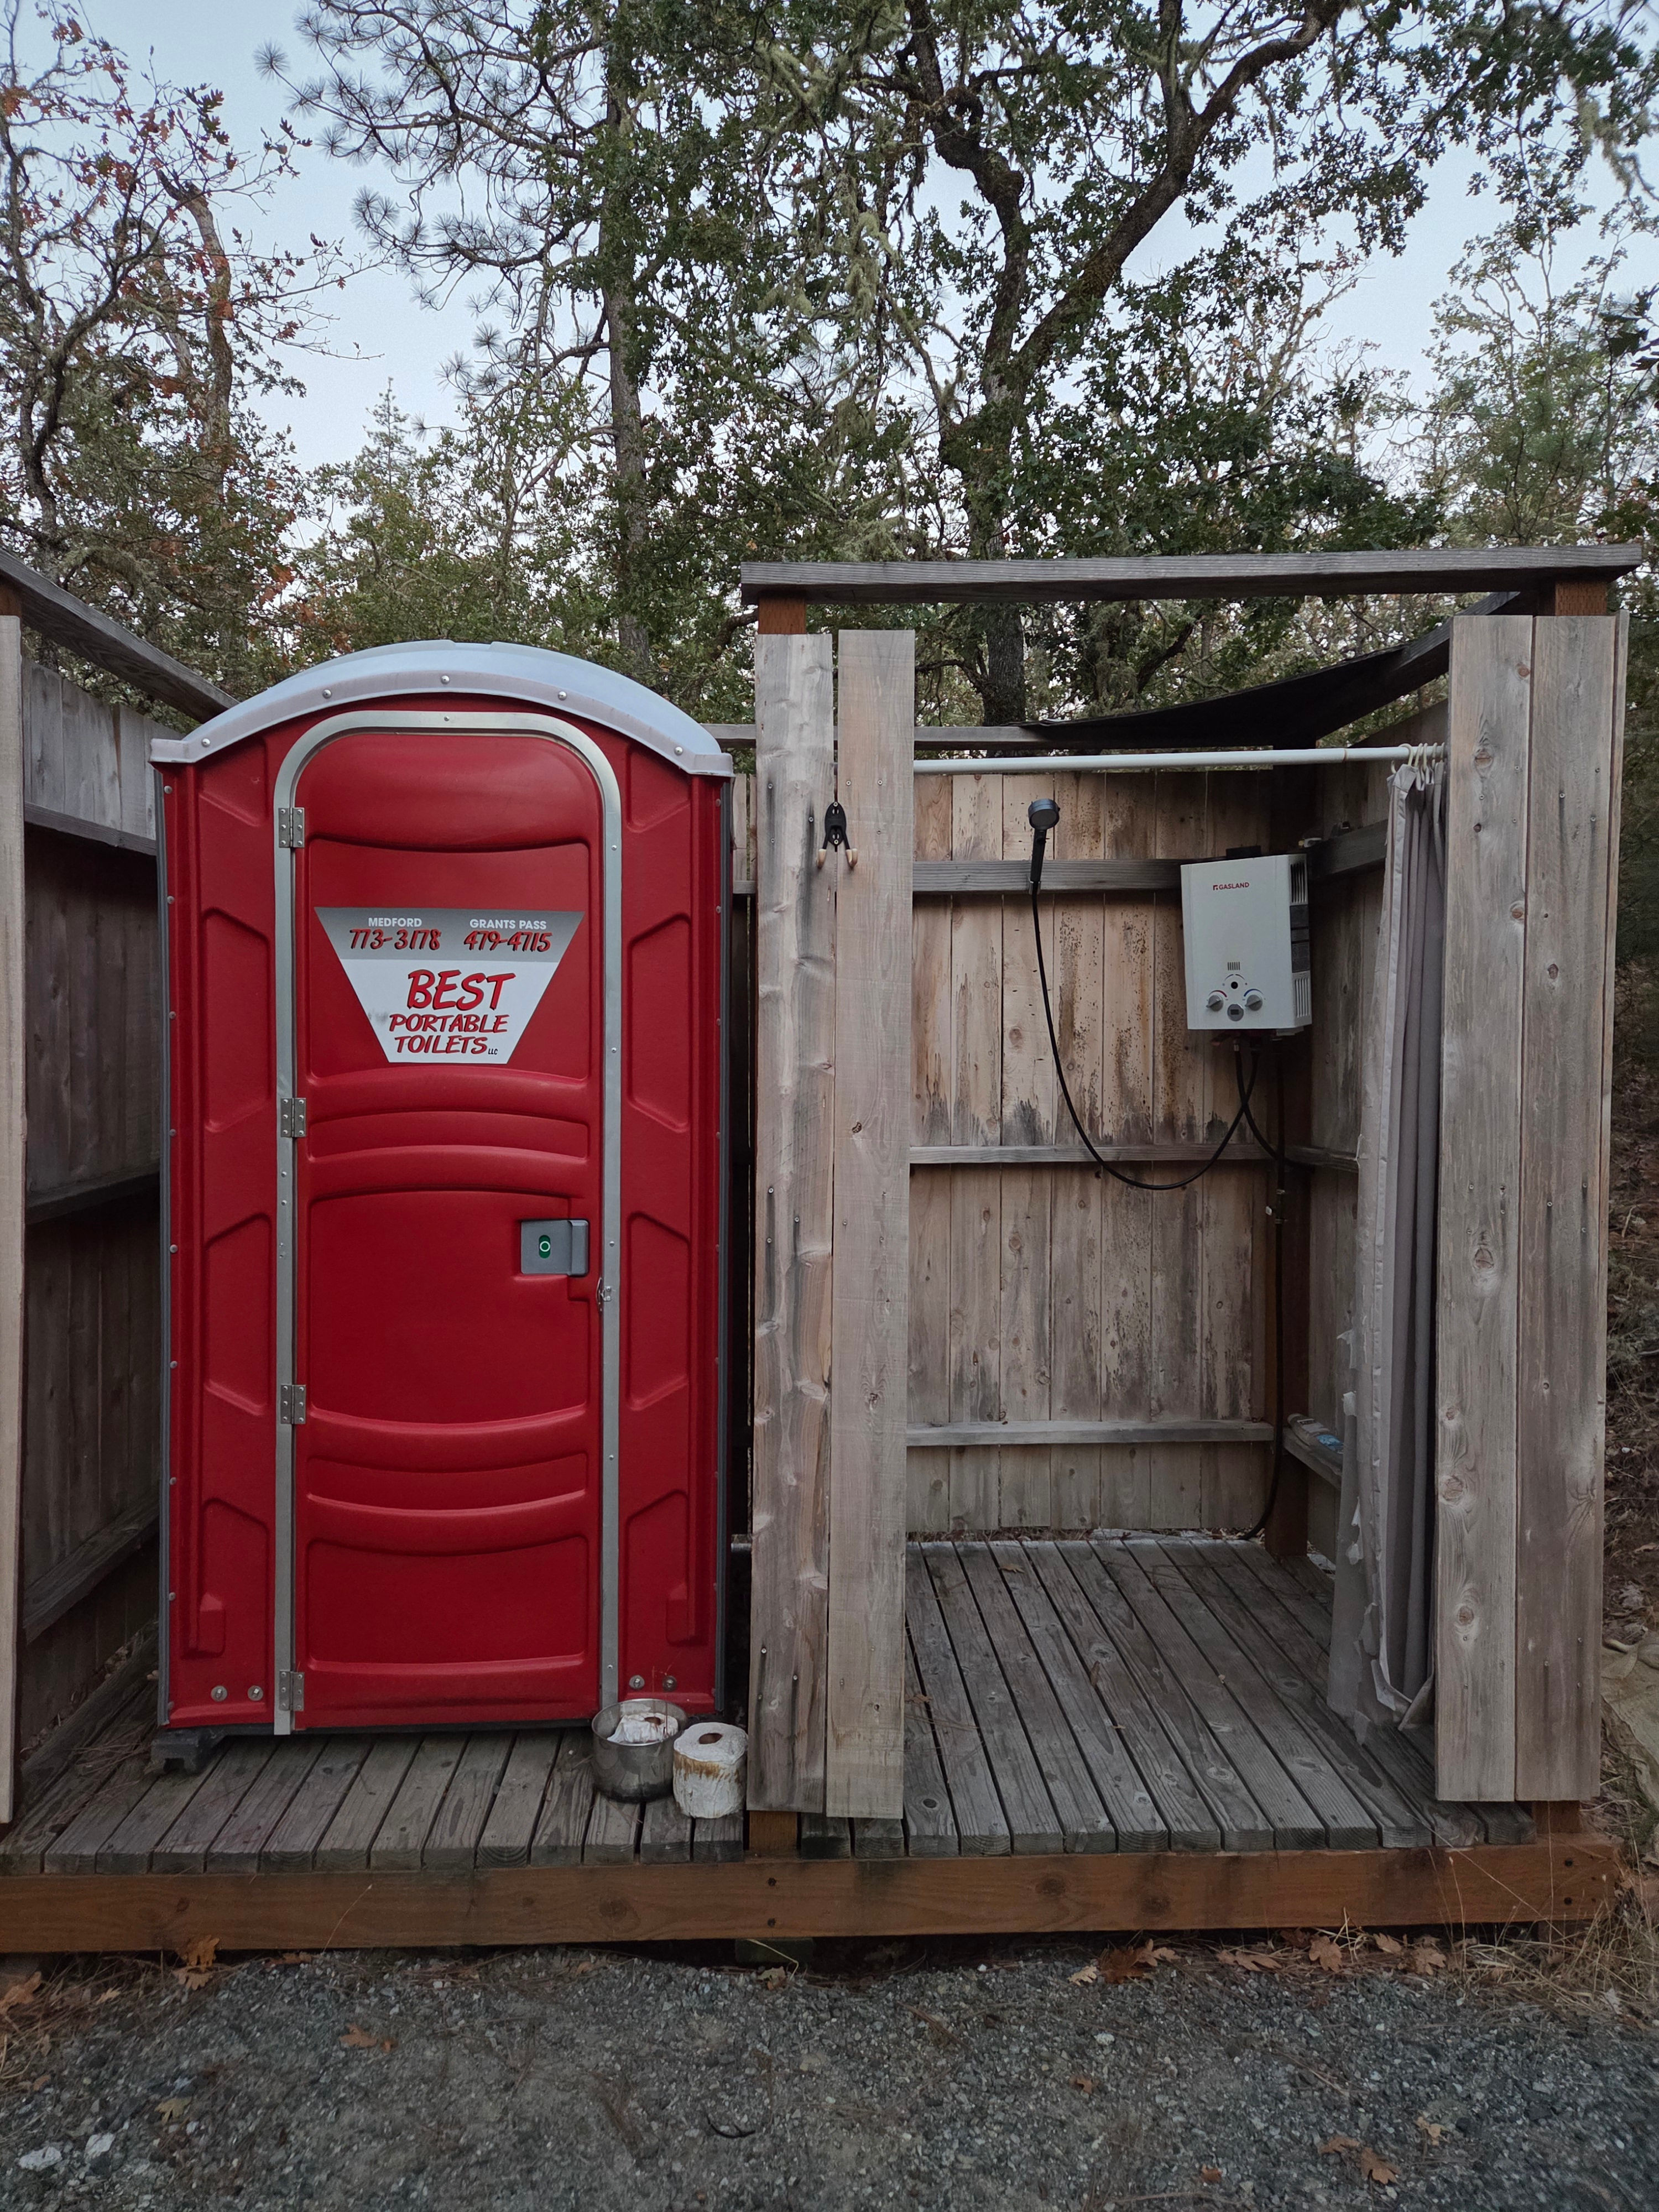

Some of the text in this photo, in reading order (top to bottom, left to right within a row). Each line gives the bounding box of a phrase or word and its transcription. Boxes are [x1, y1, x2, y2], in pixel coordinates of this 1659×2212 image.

[368, 917, 422, 927] MEDFORD
[470, 919, 546, 930] GRANTS PASS
[349, 928, 442, 950] 773-3178
[463, 930, 552, 952] 479-4715
[406, 969, 517, 1011] BEST
[389, 1014, 510, 1033] PORTABLE
[394, 1035, 488, 1054] TOILETS
